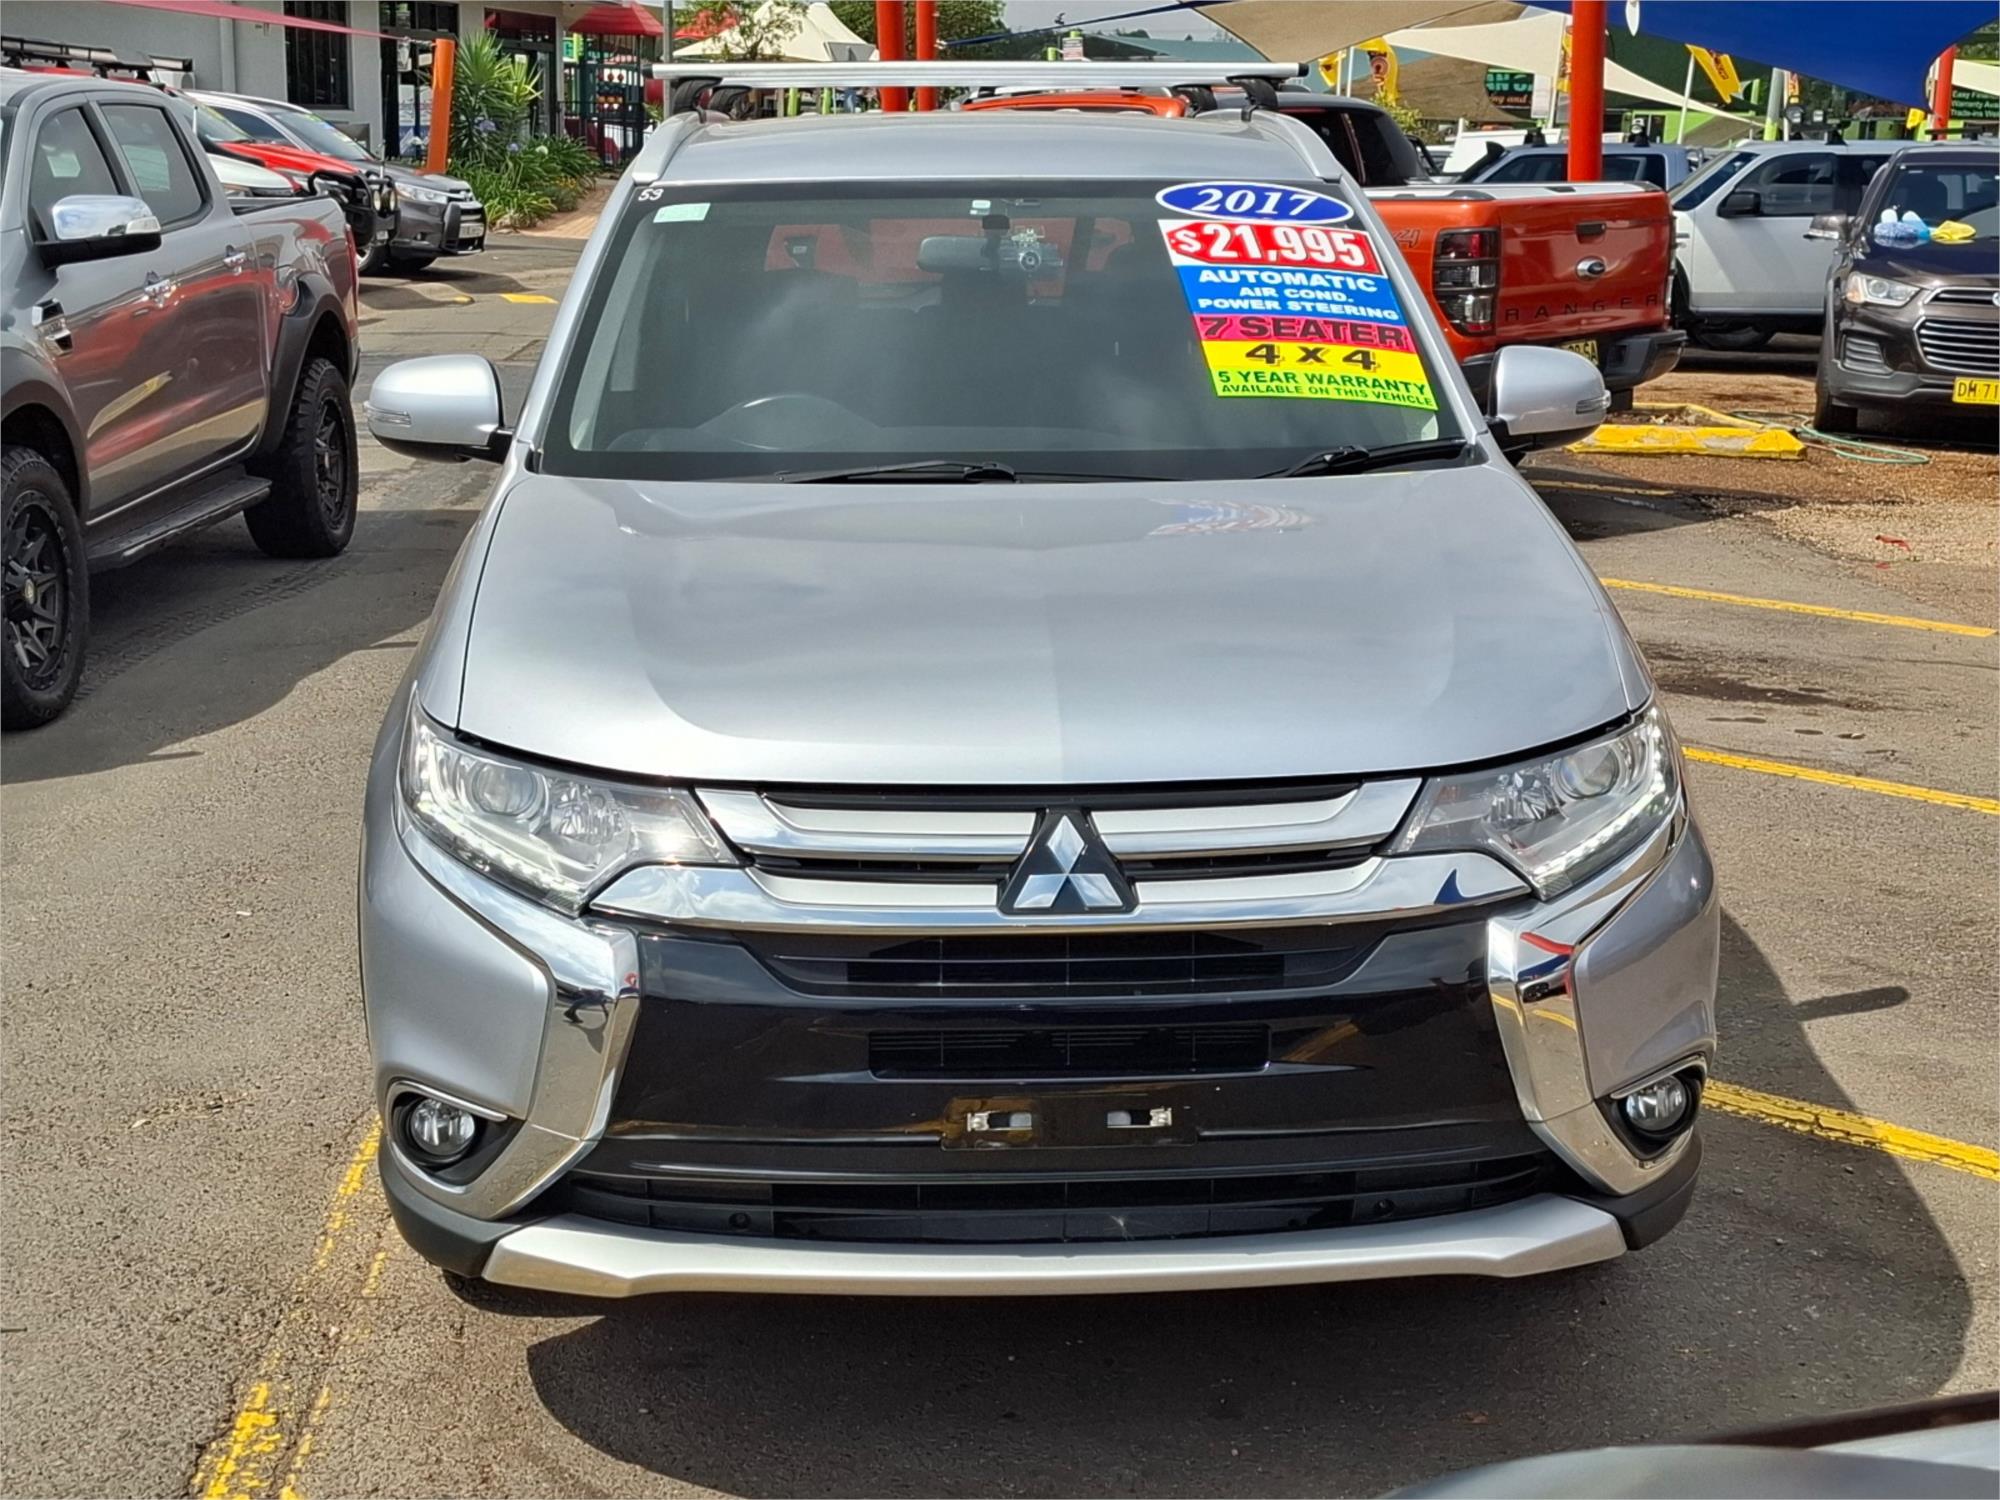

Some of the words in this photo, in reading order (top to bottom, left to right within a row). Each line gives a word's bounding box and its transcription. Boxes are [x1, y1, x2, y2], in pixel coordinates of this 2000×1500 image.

[638, 188, 664, 201] 59
[1191, 188, 1319, 216] 2017
[1171, 223, 1366, 267] $21,995
[1199, 269, 1379, 293] AUTOMATIC
[1239, 287, 1279, 298] AIR
[1283, 288, 1354, 302] COND.
[1198, 298, 1282, 311] POWER
[1286, 300, 1400, 321] STEERING
[1504, 294, 1658, 322] RANGER
[1200, 316, 1231, 337] 7
[1240, 316, 1405, 348] SEATER
[1245, 343, 1284, 366] 4
[1342, 349, 1380, 372] 4
[1218, 371, 1231, 384] 5
[1237, 371, 1298, 385] YEAR
[1304, 372, 1427, 396] WARRANTY
[1222, 384, 1303, 395] AVAILABLE
[1308, 385, 1330, 395] ON
[1334, 387, 1369, 398] THIS
[1373, 390, 1434, 407] VEHICLE
